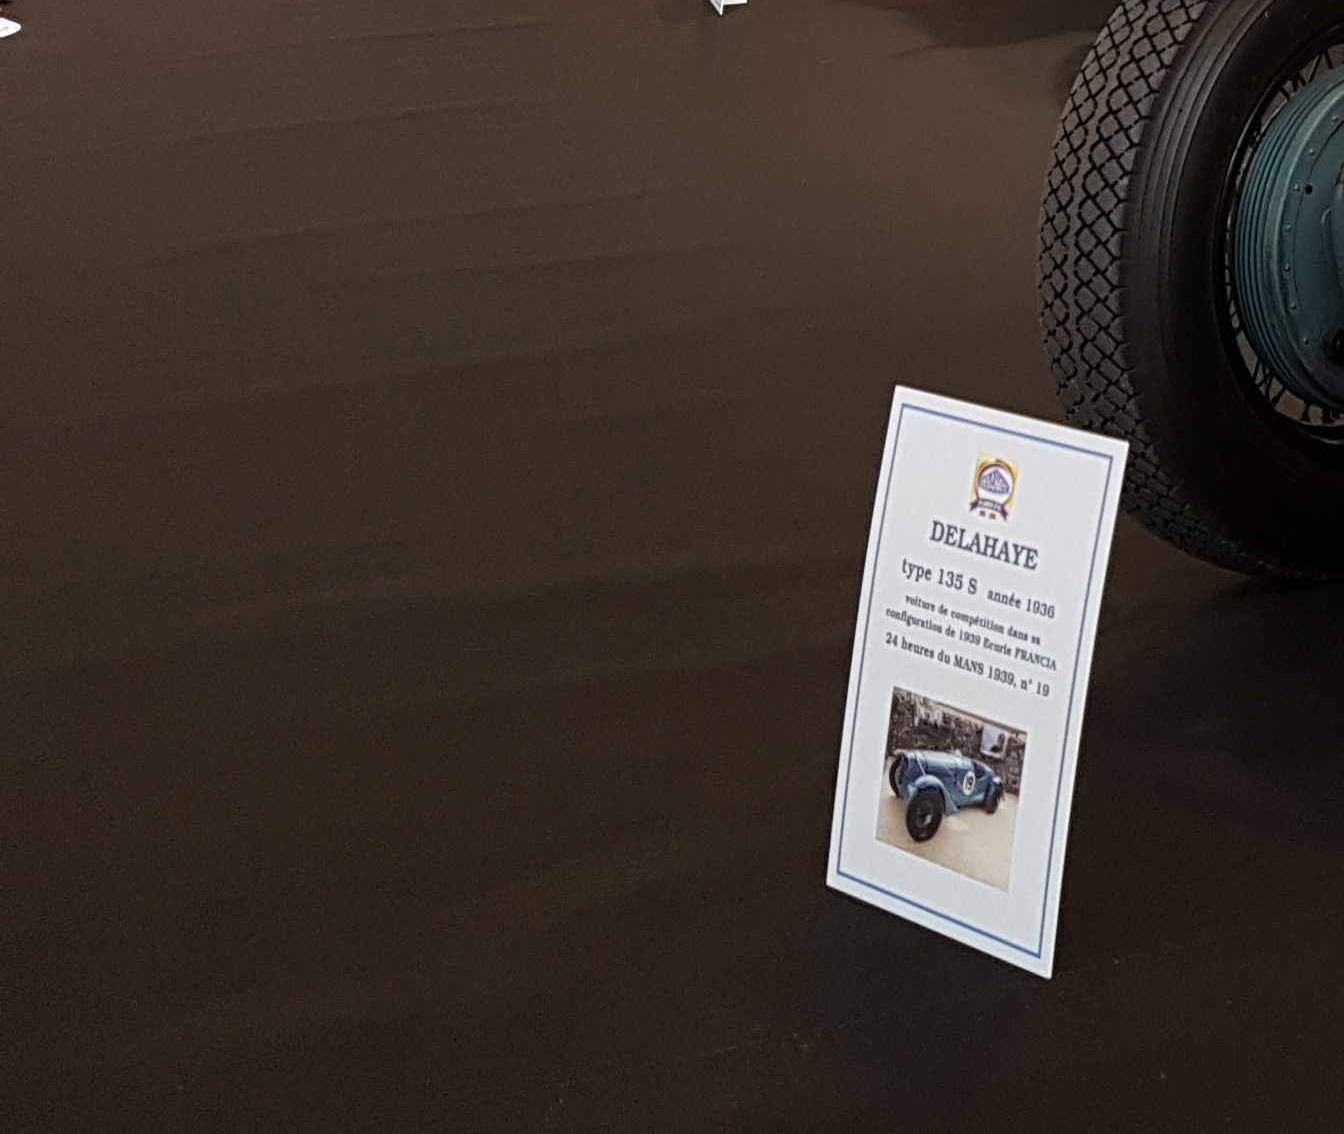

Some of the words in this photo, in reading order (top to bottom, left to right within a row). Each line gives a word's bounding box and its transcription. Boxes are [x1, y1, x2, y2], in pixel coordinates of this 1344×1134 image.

[930, 519, 1039, 570] DELAHAYE
[902, 558, 932, 582] type
[938, 568, 963, 590] 135
[967, 578, 978, 595] S
[905, 594, 935, 613] voiture
[938, 603, 949, 616] de
[951, 608, 1005, 635] compétition
[1007, 624, 1028, 640] dans
[1031, 635, 1041, 646] sa
[987, 587, 1021, 609] année
[1026, 598, 1055, 619] 1936
[885, 607, 943, 634] configuration
[945, 623, 956, 637] de
[959, 628, 981, 647] 1939
[983, 637, 1012, 657] Ecurie
[1014, 647, 1057, 671] FRANCIA
[885, 632, 899, 647] 24
[901, 636, 935, 659] heures
[938, 649, 951, 664] du
[953, 653, 985, 675] MANS
[1036, 680, 1050, 697] 19
